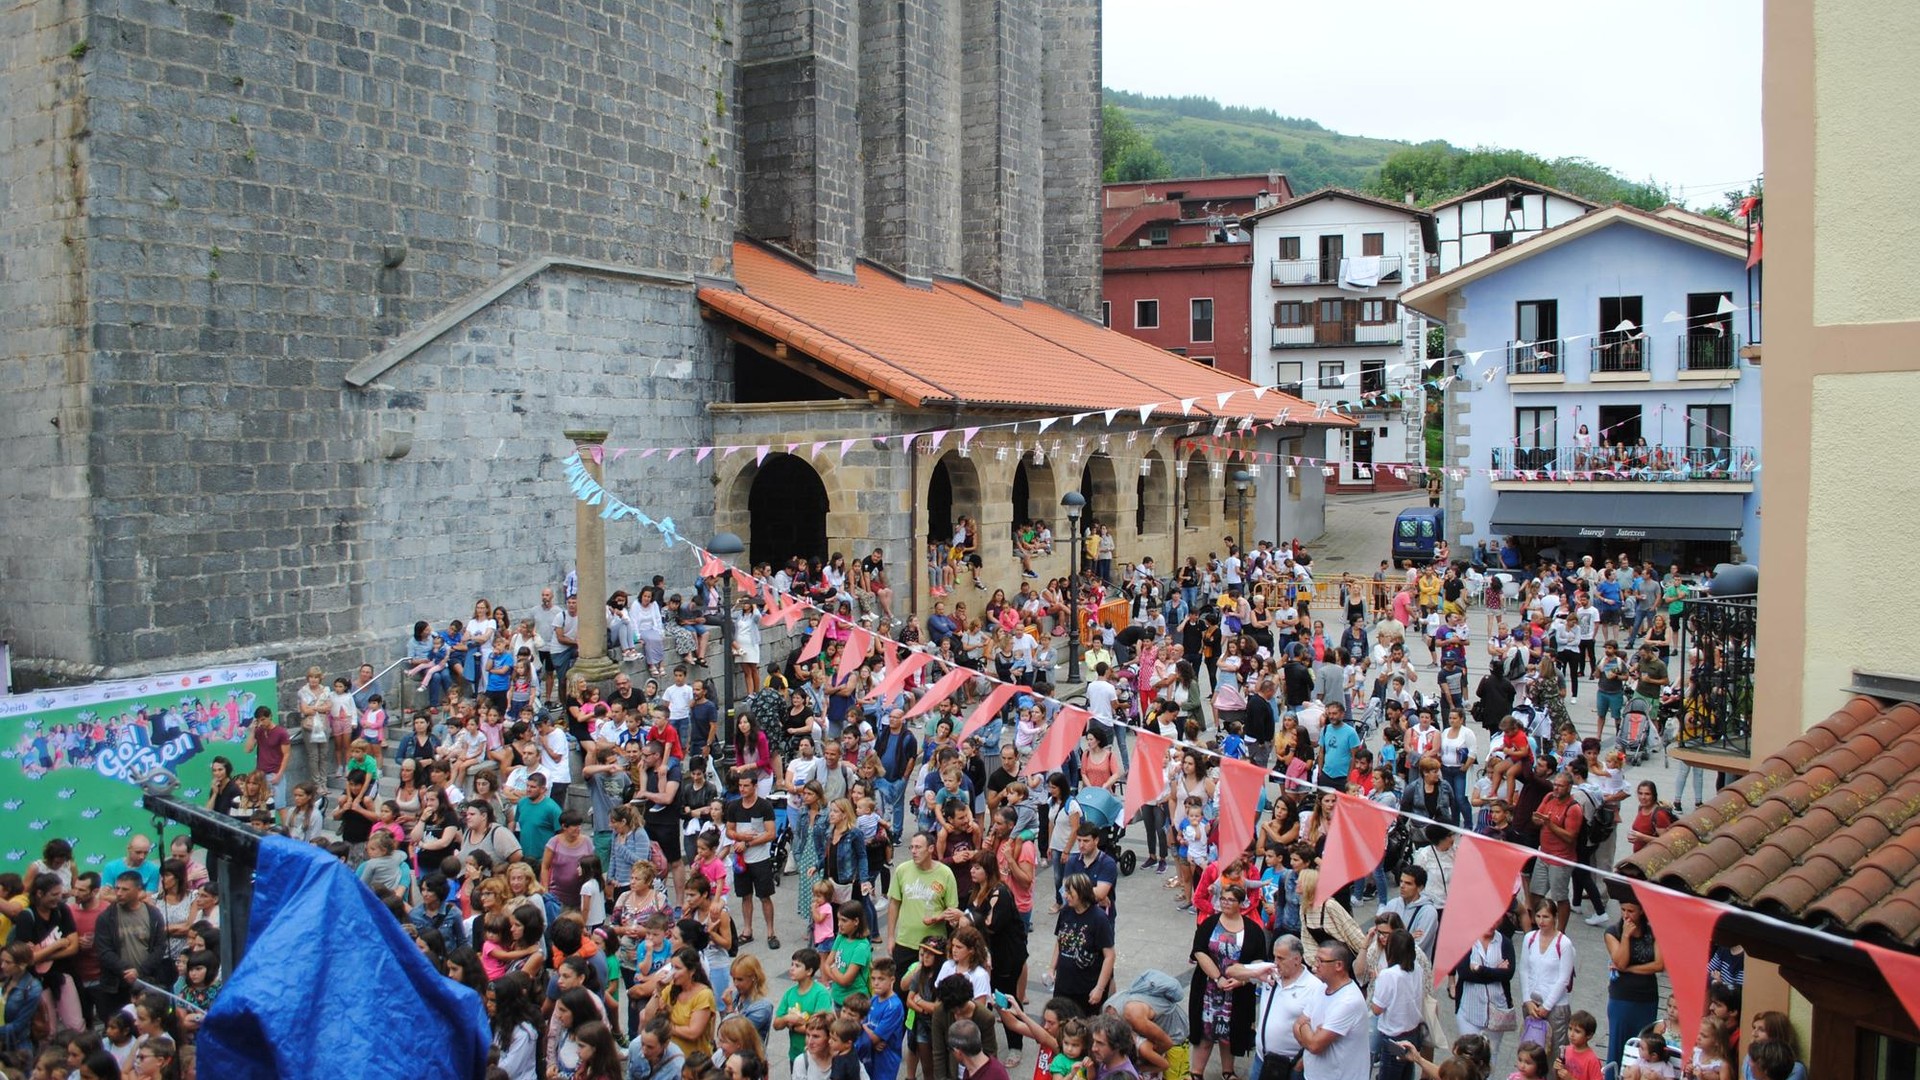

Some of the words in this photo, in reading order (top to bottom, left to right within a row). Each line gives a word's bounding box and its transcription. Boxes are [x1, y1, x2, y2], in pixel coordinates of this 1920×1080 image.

[1579, 527, 1605, 538] Jauregi
[1616, 528, 1646, 537] Jatetxea
[254, 669, 269, 677] eitb
[9, 702, 28, 713] eitb
